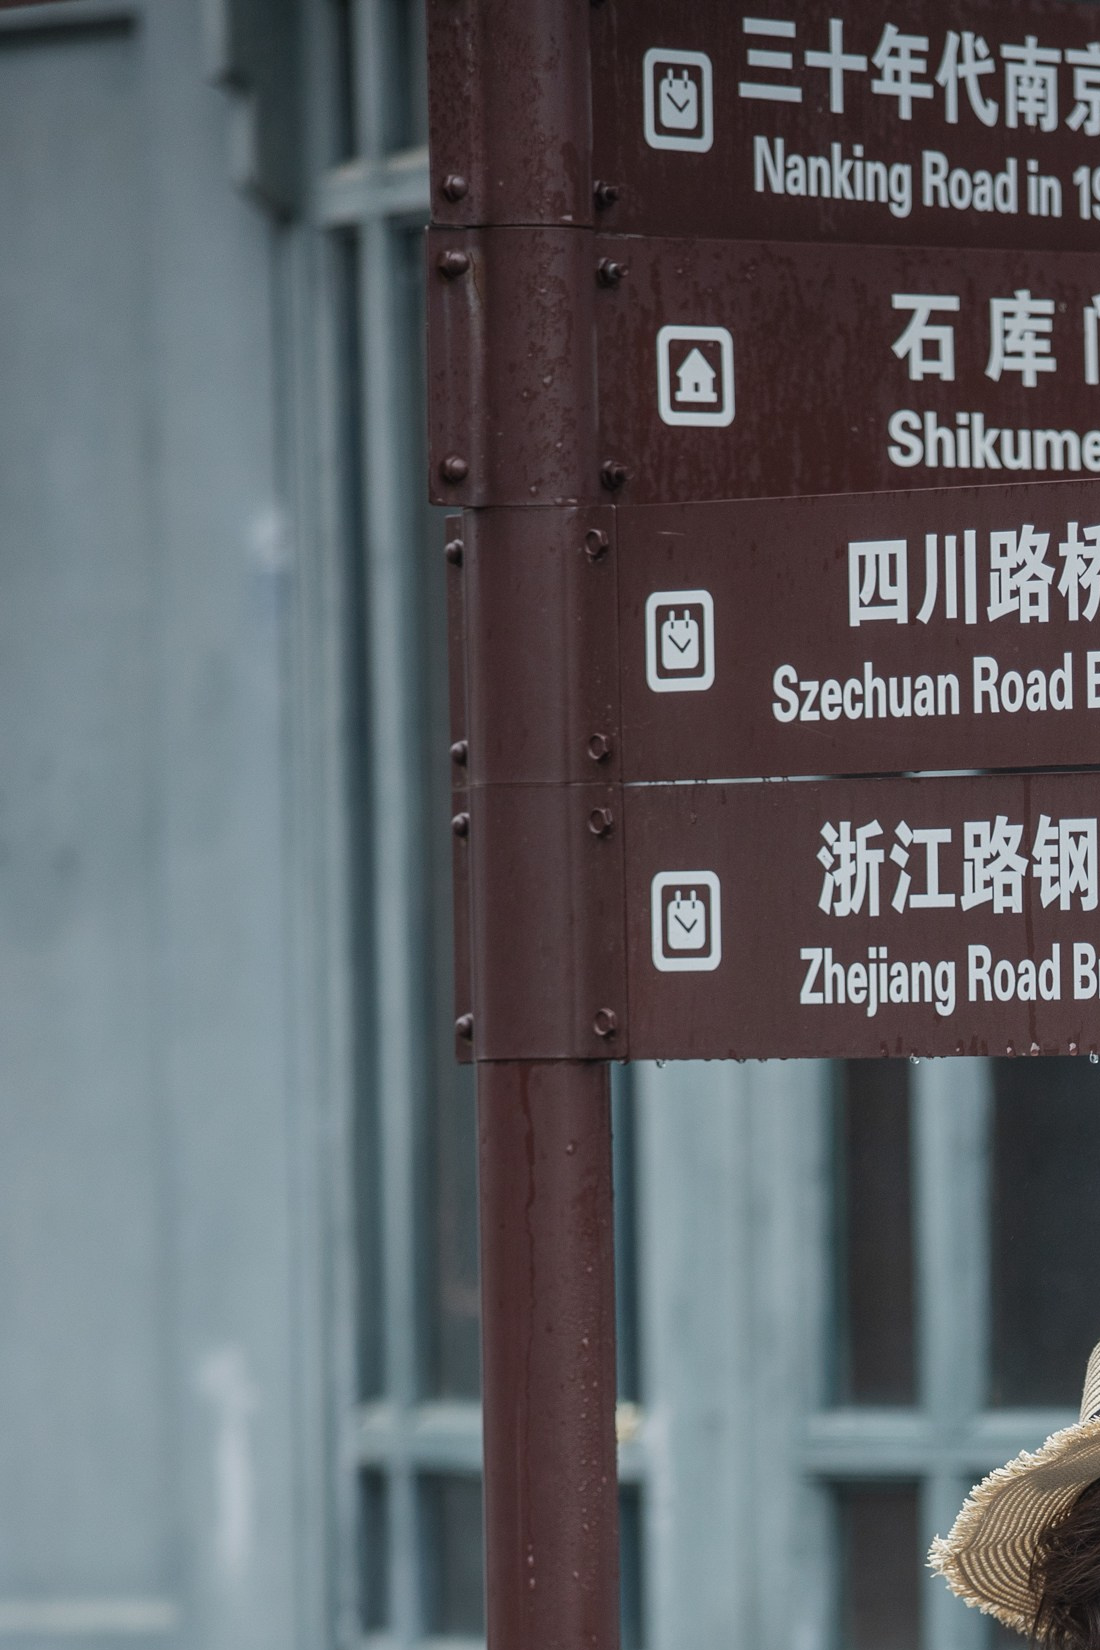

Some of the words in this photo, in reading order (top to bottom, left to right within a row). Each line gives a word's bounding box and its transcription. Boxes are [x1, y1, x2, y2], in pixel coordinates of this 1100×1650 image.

[755, 136, 912, 218] Nanking
[923, 151, 1017, 214] Road
[1027, 159, 1062, 217] in
[772, 661, 960, 723] Szechuan
[973, 652, 1074, 714] Road
[799, 946, 956, 1018] Zhejiang
[967, 942, 1061, 1002] Road
